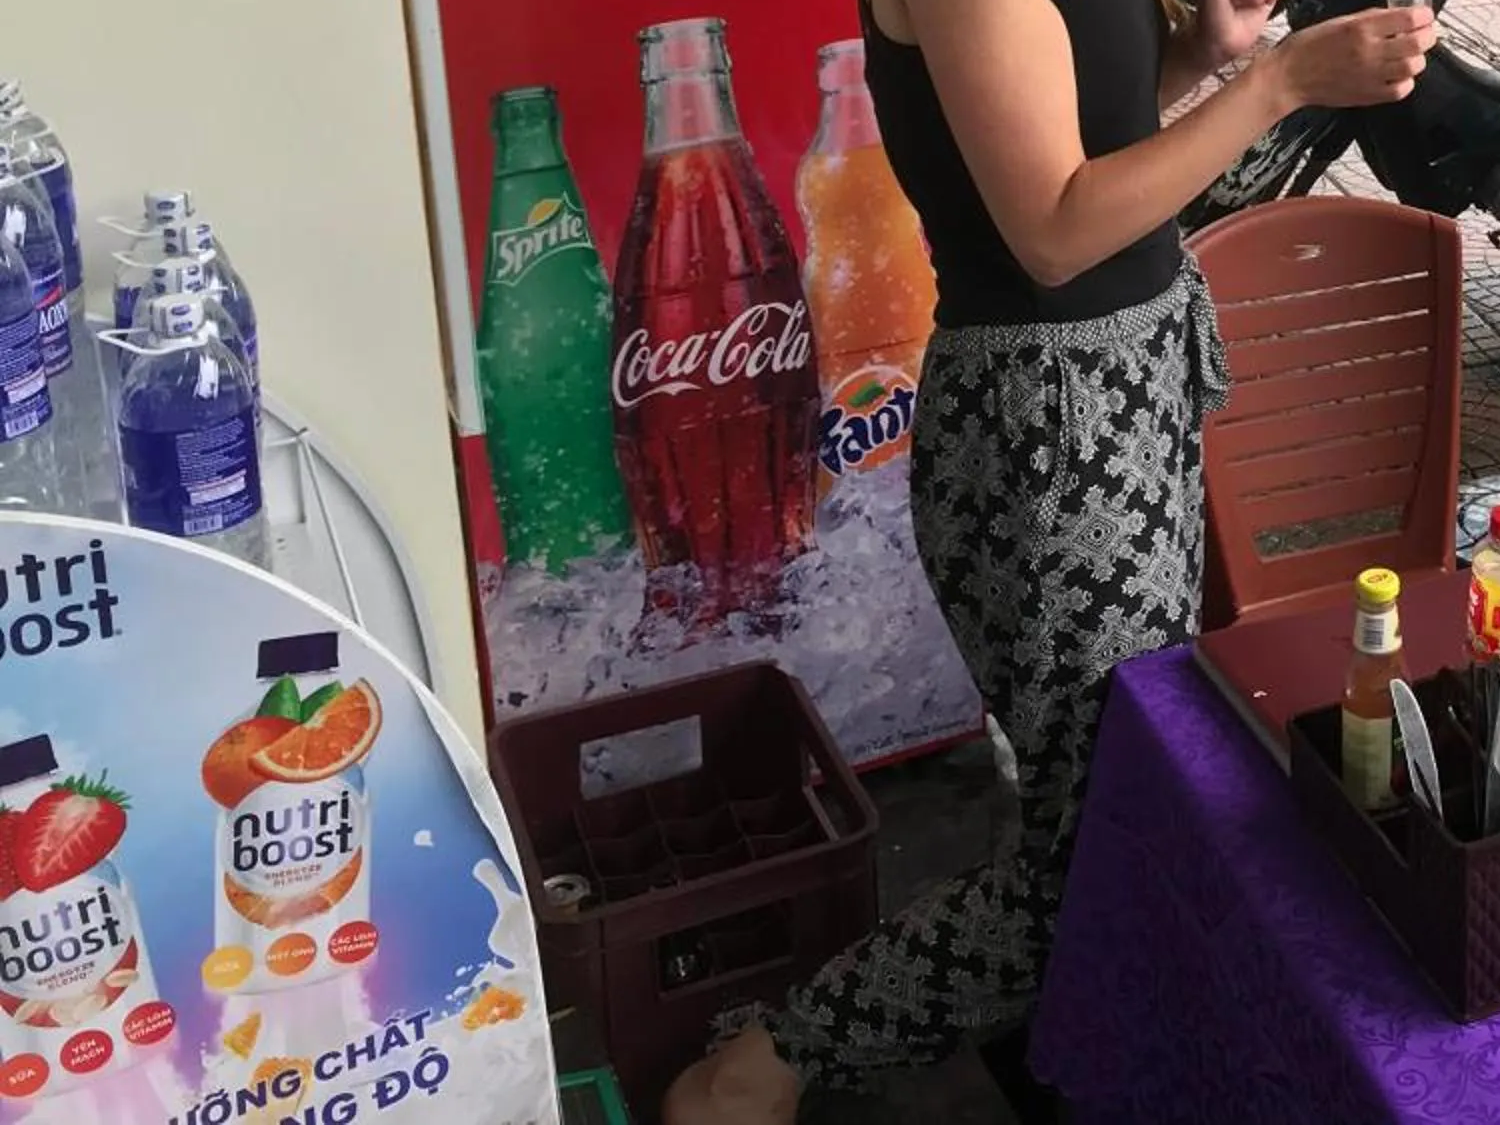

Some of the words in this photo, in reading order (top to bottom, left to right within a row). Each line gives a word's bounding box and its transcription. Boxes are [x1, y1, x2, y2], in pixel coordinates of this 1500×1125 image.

[496, 211, 583, 279] Sprite
[611, 301, 811, 410] Coca-Cola
[817, 386, 915, 476] Fant
[233, 789, 350, 838] nutri
[233, 822, 353, 872] boost
[0, 886, 111, 950] nutri
[0, 916, 120, 983] boost
[314, 1007, 432, 1082] CHẤT
[372, 1045, 449, 1111] ĐỘ
